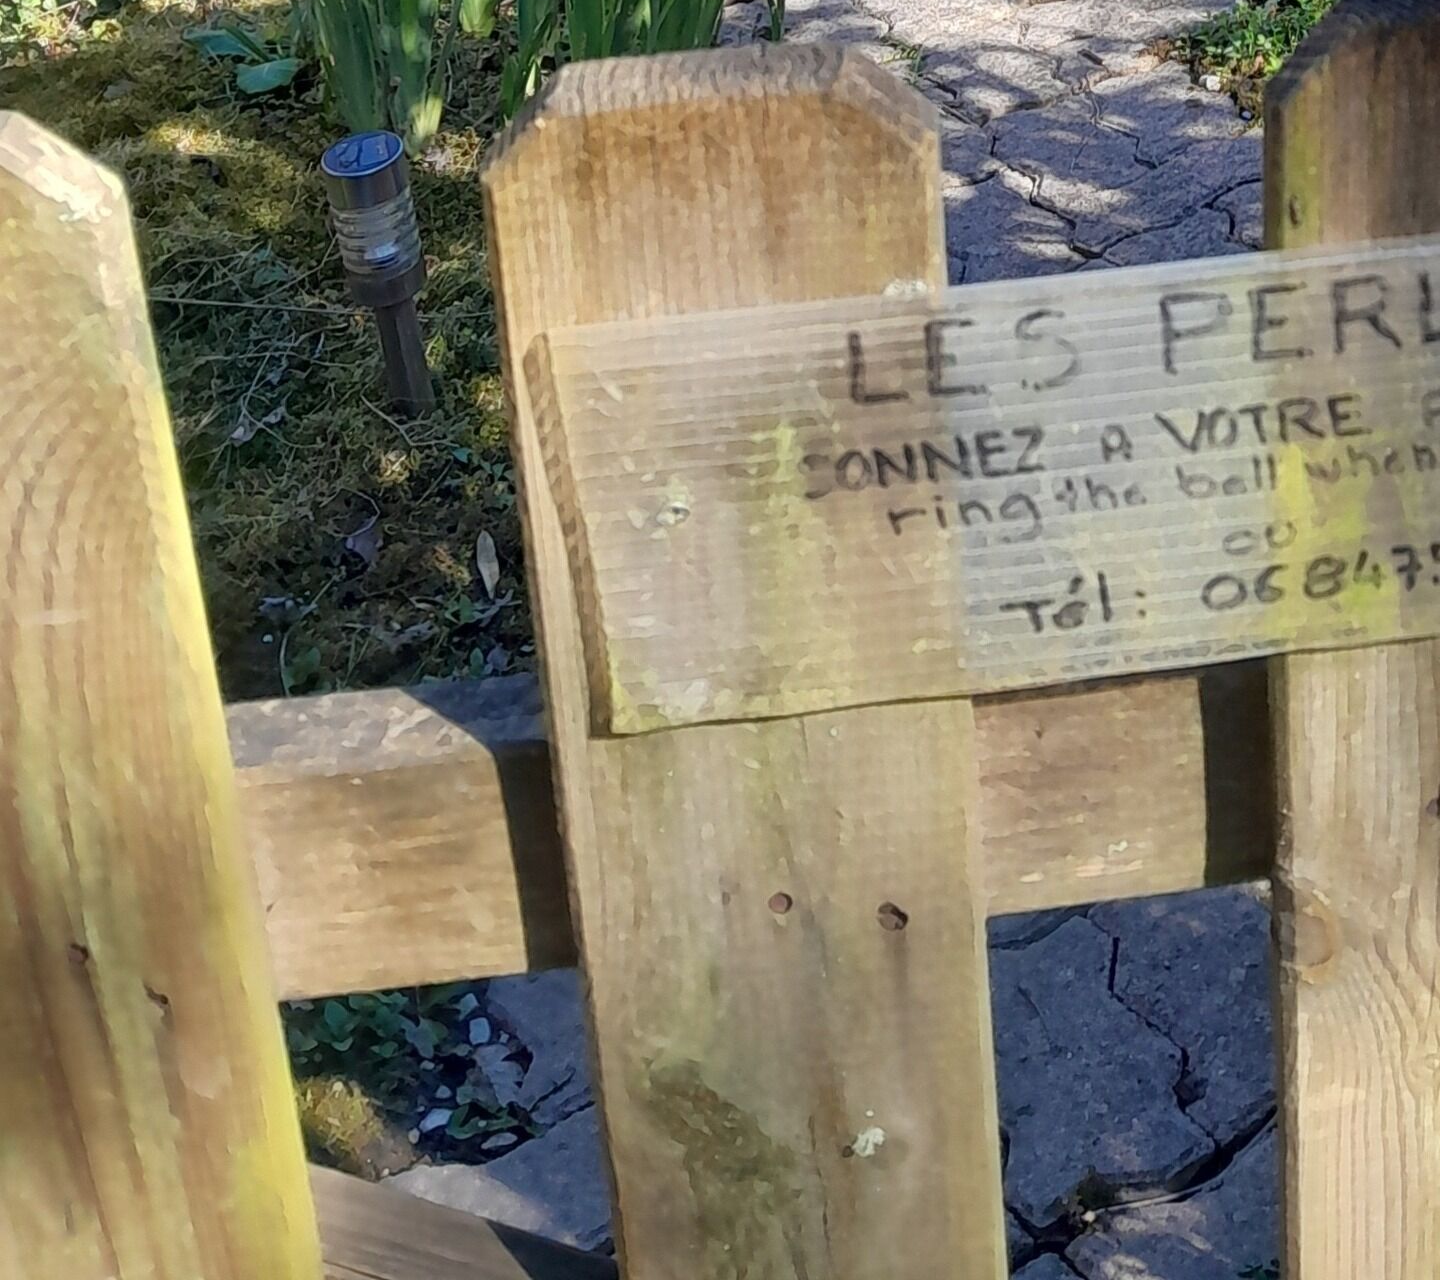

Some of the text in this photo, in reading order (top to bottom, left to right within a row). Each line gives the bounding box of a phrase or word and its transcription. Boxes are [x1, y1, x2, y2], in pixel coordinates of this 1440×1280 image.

[847, 308, 1083, 404] LES
[799, 425, 1046, 501] SONNEZ
[1153, 392, 1374, 453] VOTRE
[888, 492, 1043, 543] ring
[1304, 441, 1437, 483] when
